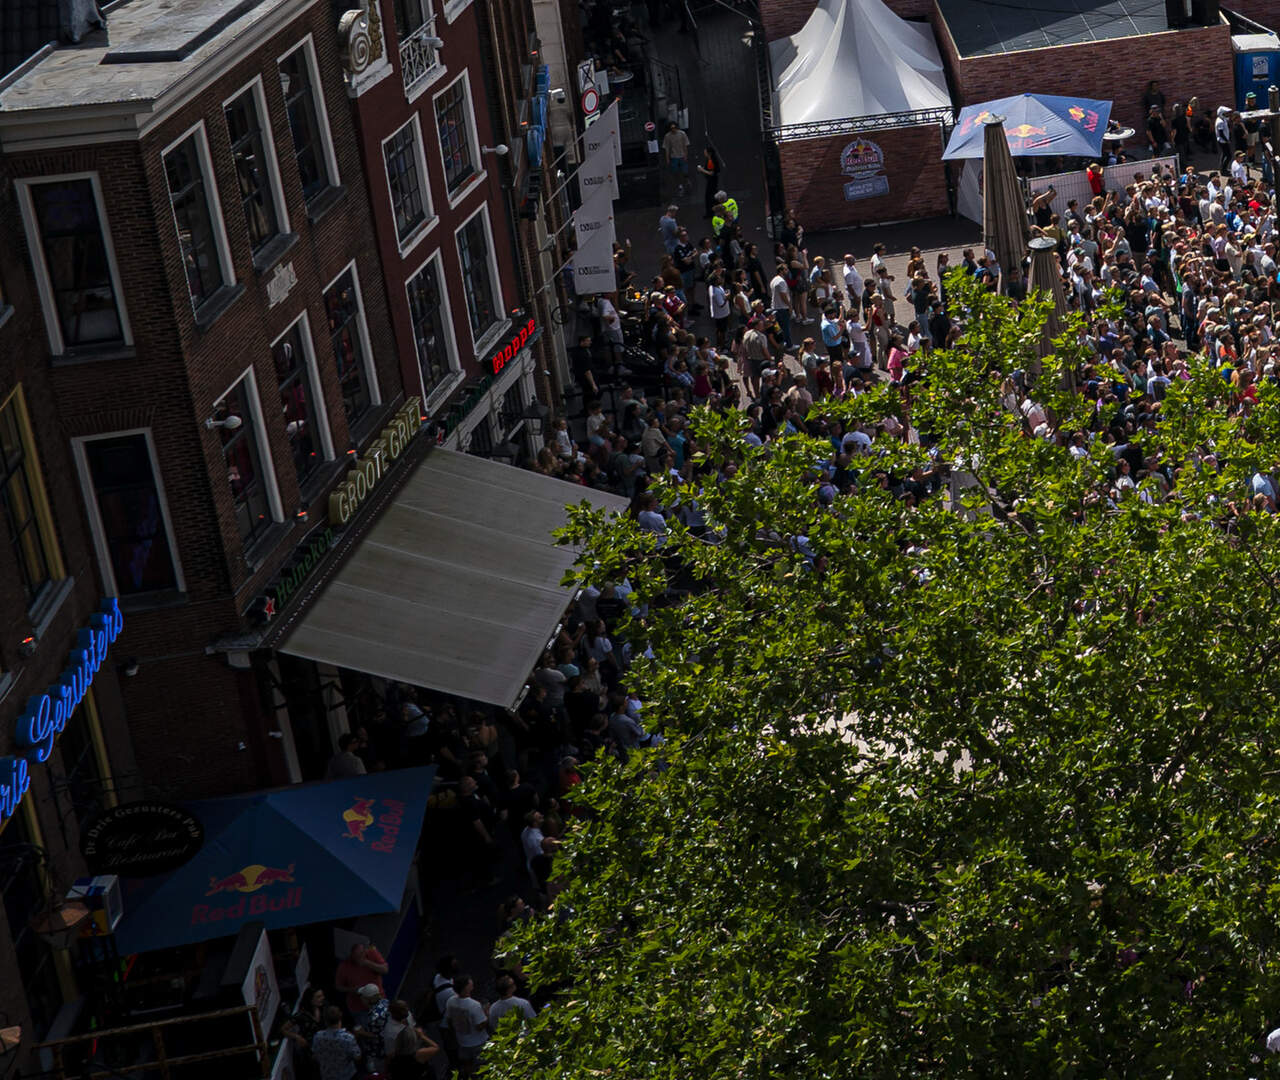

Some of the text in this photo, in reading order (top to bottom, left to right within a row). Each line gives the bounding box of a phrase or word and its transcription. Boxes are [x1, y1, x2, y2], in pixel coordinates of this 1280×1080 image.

[492, 320, 536, 375] Hoppe
[340, 400, 421, 523] GROOTE GRIET
[275, 526, 335, 610] Heineken
[0, 758, 30, 824] rie
[192, 887, 303, 926] Red Bull
